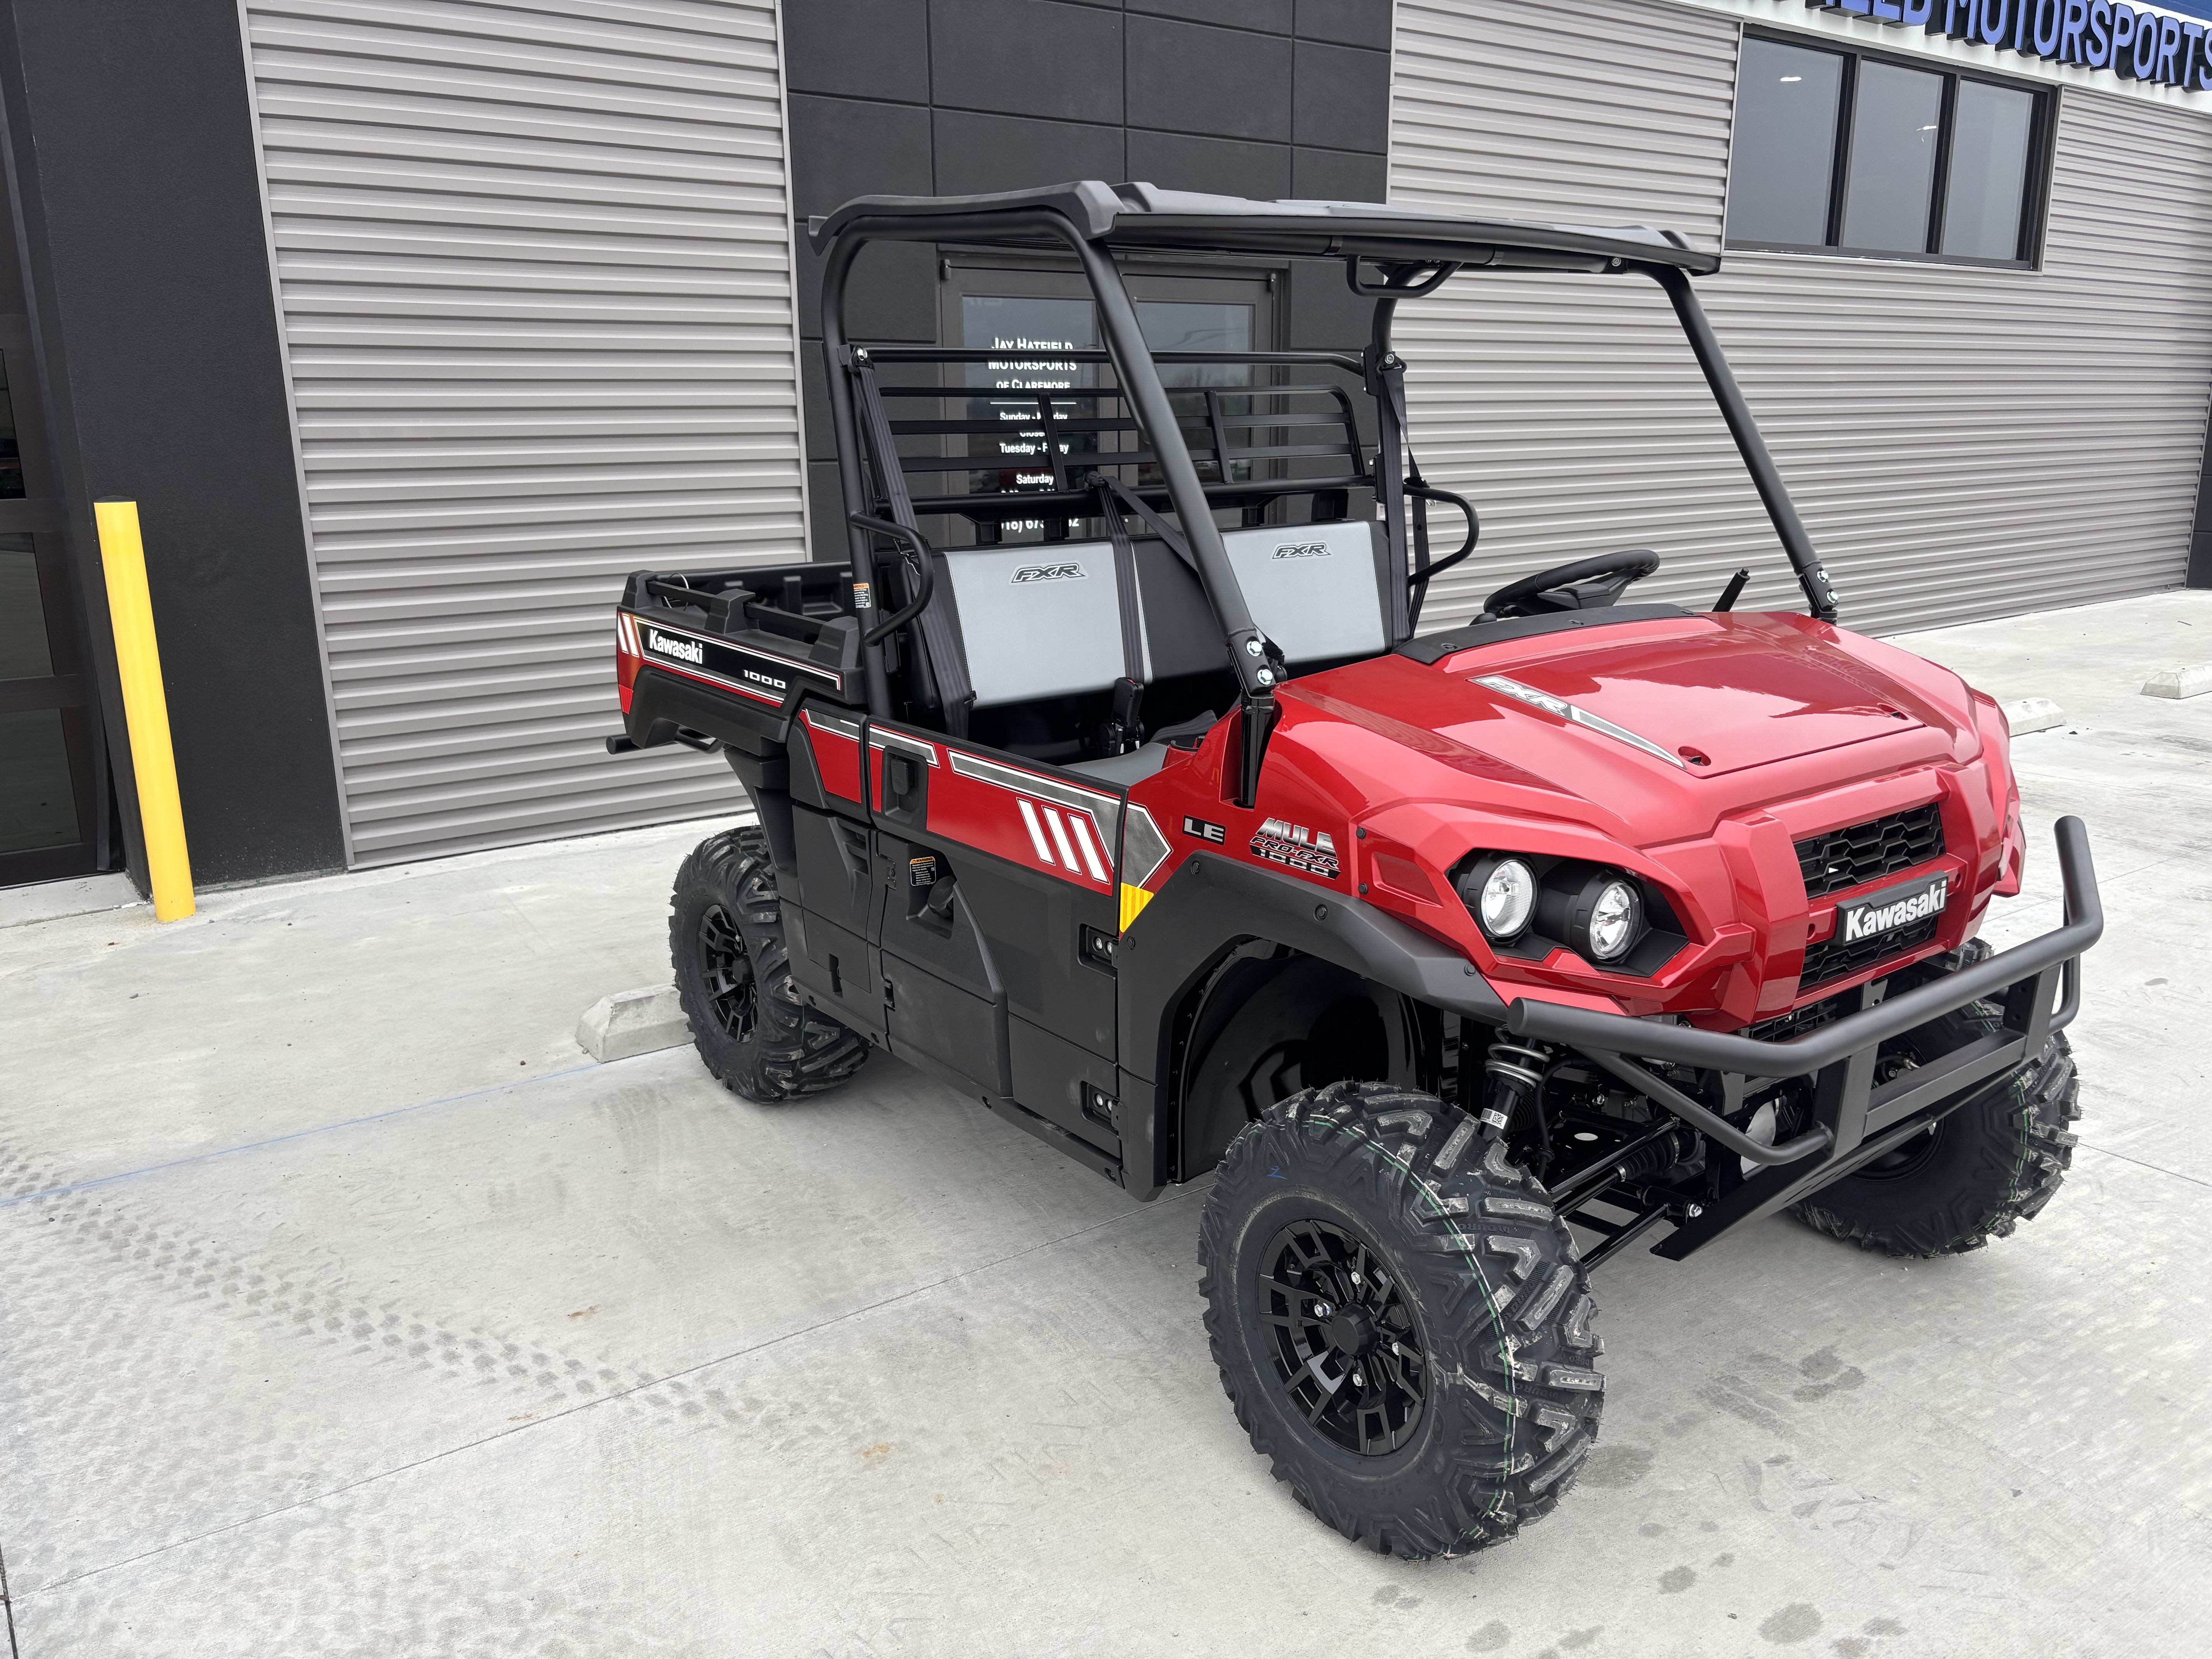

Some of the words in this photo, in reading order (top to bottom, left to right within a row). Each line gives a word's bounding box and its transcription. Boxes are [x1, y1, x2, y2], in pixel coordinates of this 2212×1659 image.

[991, 337, 1014, 349] JAY
[1000, 412, 1030, 420] Sunday
[1000, 443, 1036, 455] Tuesday
[1042, 443, 1069, 454] Fay
[1016, 474, 1054, 485] Saturday
[1272, 543, 1331, 559] FXR
[1011, 563, 1086, 583] FXR
[649, 629, 703, 664] Kawasaki
[744, 670, 786, 689] 1000
[1475, 677, 1567, 716] FXR
[1184, 818, 1224, 842] LE
[1255, 817, 1338, 859] MULE
[1249, 836, 1340, 870] PRO-FXR
[1260, 848, 1329, 876] 1000
[1845, 880, 1947, 942] Kawasaki
[1457, 1223, 1496, 1233] DURO
